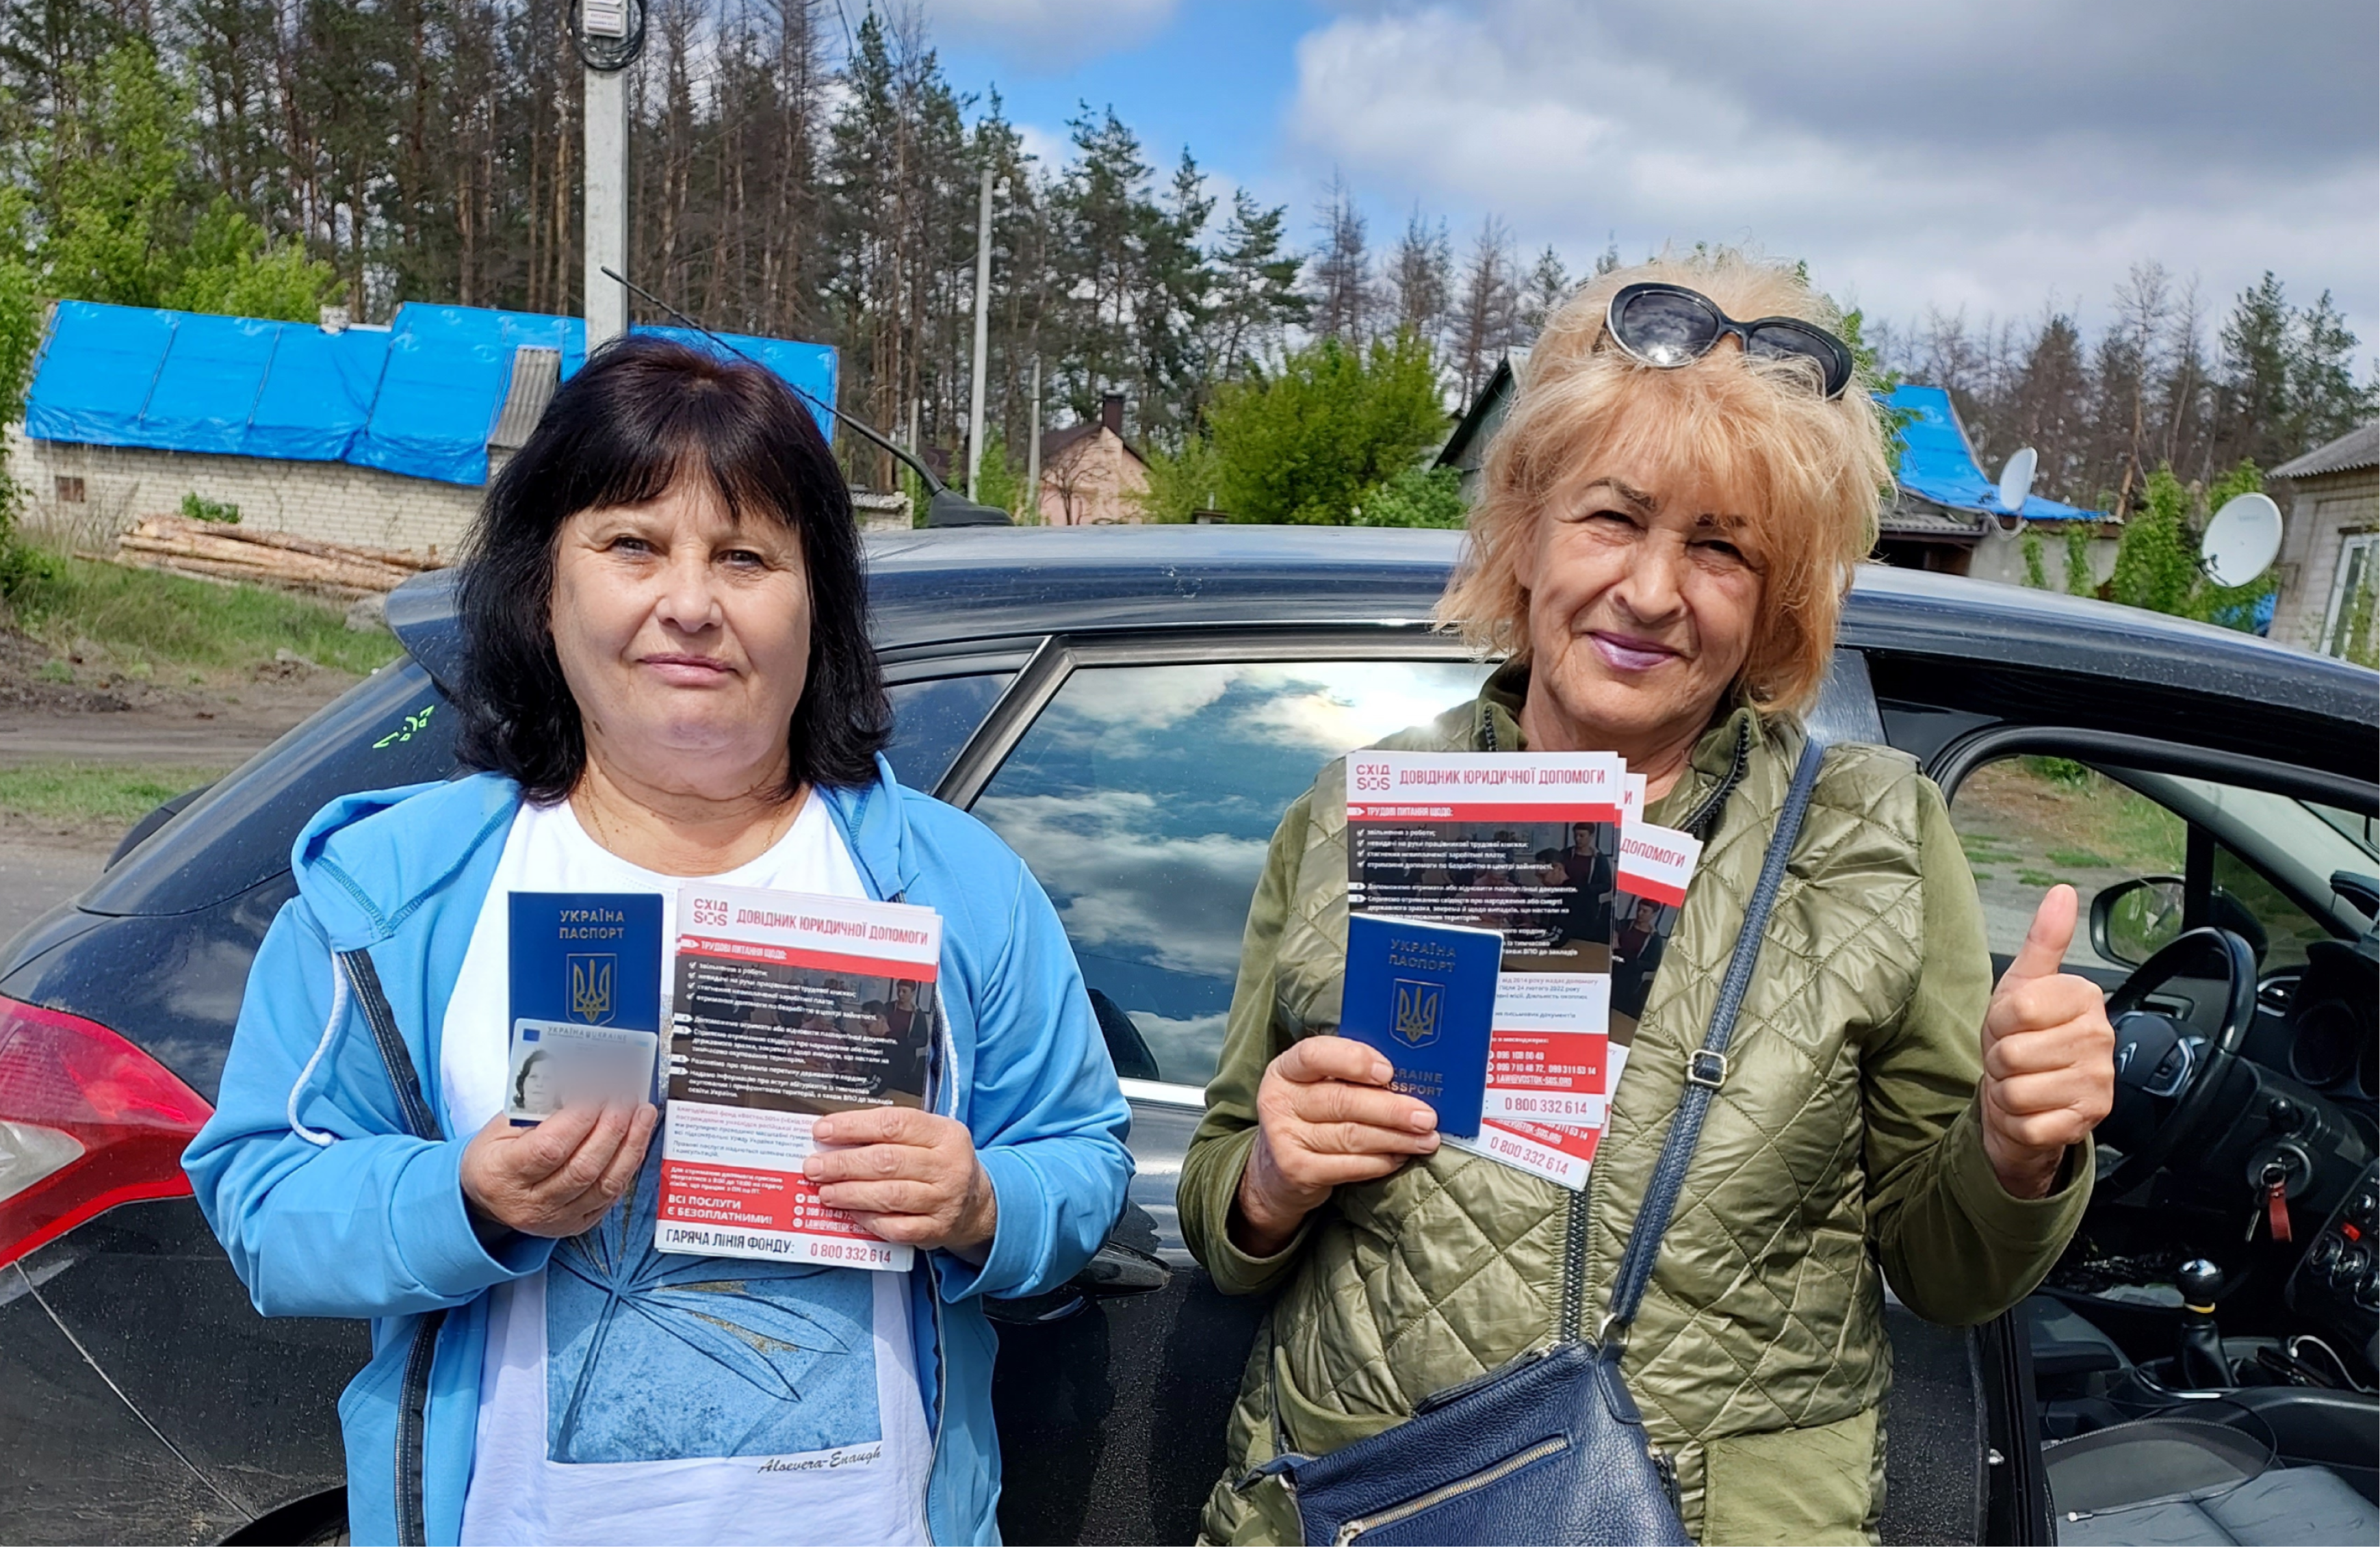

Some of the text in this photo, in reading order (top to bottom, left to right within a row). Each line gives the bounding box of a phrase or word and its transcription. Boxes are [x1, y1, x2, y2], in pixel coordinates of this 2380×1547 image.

[1356, 764, 1391, 775] СХІД
[1399, 767, 1605, 785] ДОВІДНИК ЮРИДИЧНОЇ ДОПОМОГИ
[1356, 777, 1391, 790] SOS
[1367, 807, 1453, 817] ТРУДОВІ ПИТАННЯ ЩОДО:
[1470, 840, 1500, 849] трудової
[1620, 837, 1685, 868] ДОПОМОГИ
[1492, 861, 1514, 870] центрі
[1459, 883, 1492, 893] відновити
[693, 898, 728, 912] СХІД
[559, 909, 625, 923] УКРАЇНА
[693, 910, 727, 926] SOS
[559, 927, 625, 939] ПАСПОРТ
[736, 908, 928, 945] ДОВІДНИК ЮРИДИЧНОЇ ДОПОМОГИ
[701, 939, 730, 952] ТРУДОВІ
[731, 944, 763, 957] ПИТАННЯ
[1391, 939, 1456, 957] УКРАЇНА
[1388, 954, 1456, 972] ПАСПОРТ
[548, 1026, 627, 1041] УКРАЇНА UKRAINE
[1393, 1068, 1443, 1083] KRAINE
[1384, 1081, 1443, 1097] ASSPORT
[1505, 1097, 1587, 1115] 0 800 332 614
[792, 1125, 812, 1134] агресі
[1490, 1136, 1499, 1149] 0
[1499, 1140, 1523, 1158] 800
[1523, 1149, 1545, 1167] 332
[1546, 1157, 1568, 1175] 614
[668, 1194, 741, 1210] ВСІ ПОСЛУГИ
[667, 1206, 773, 1225] Є БЕЗОПЛАТНИМИ!
[665, 1229, 794, 1254] ГАРЯЧА ЛІНІЯ ФОНДУ:
[810, 1242, 892, 1264] 0 800 332 614
